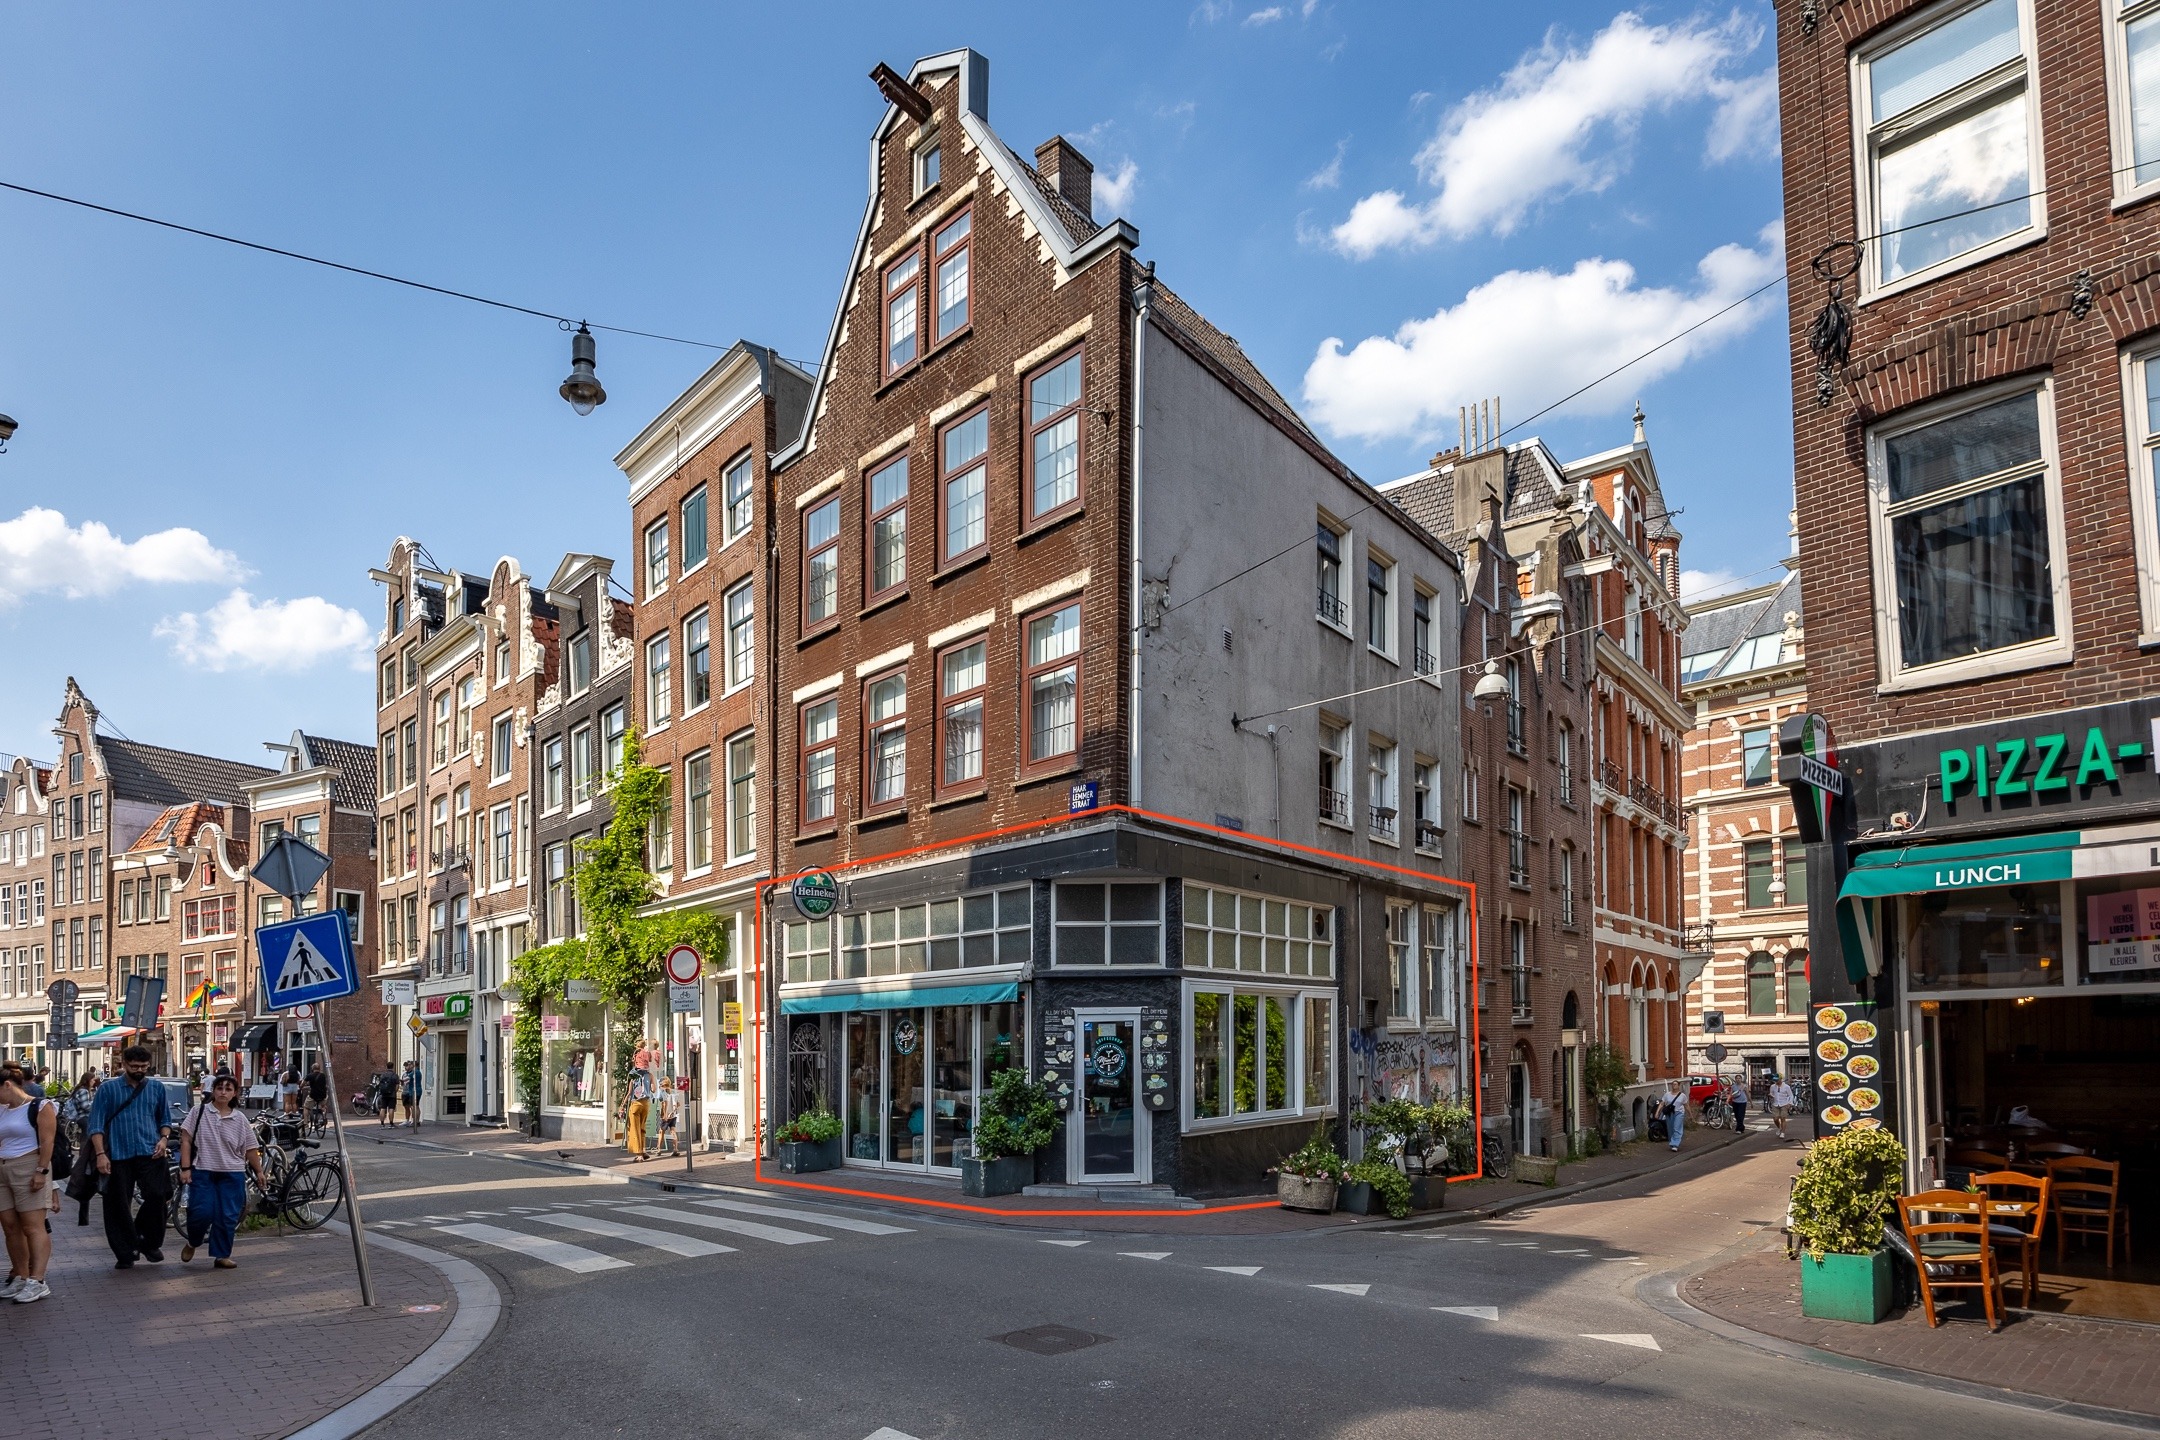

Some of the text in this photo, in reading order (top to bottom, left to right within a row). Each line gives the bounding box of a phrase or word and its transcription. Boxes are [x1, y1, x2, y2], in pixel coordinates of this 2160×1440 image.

[1801, 759, 1842, 792] PIZZERIA
[1072, 784, 1087, 793] HAAR
[1072, 790, 1094, 801] LEMMER
[1072, 799, 1091, 809] STRAAT
[1935, 863, 2021, 887] LUNCH
[797, 886, 836, 899] Heineken
[2112, 914, 2134, 923] VIEREN
[2109, 924, 2135, 934] LIEFDE
[2113, 946, 2137, 956] IN ALLE
[2109, 956, 2137, 966] KLEUREN
